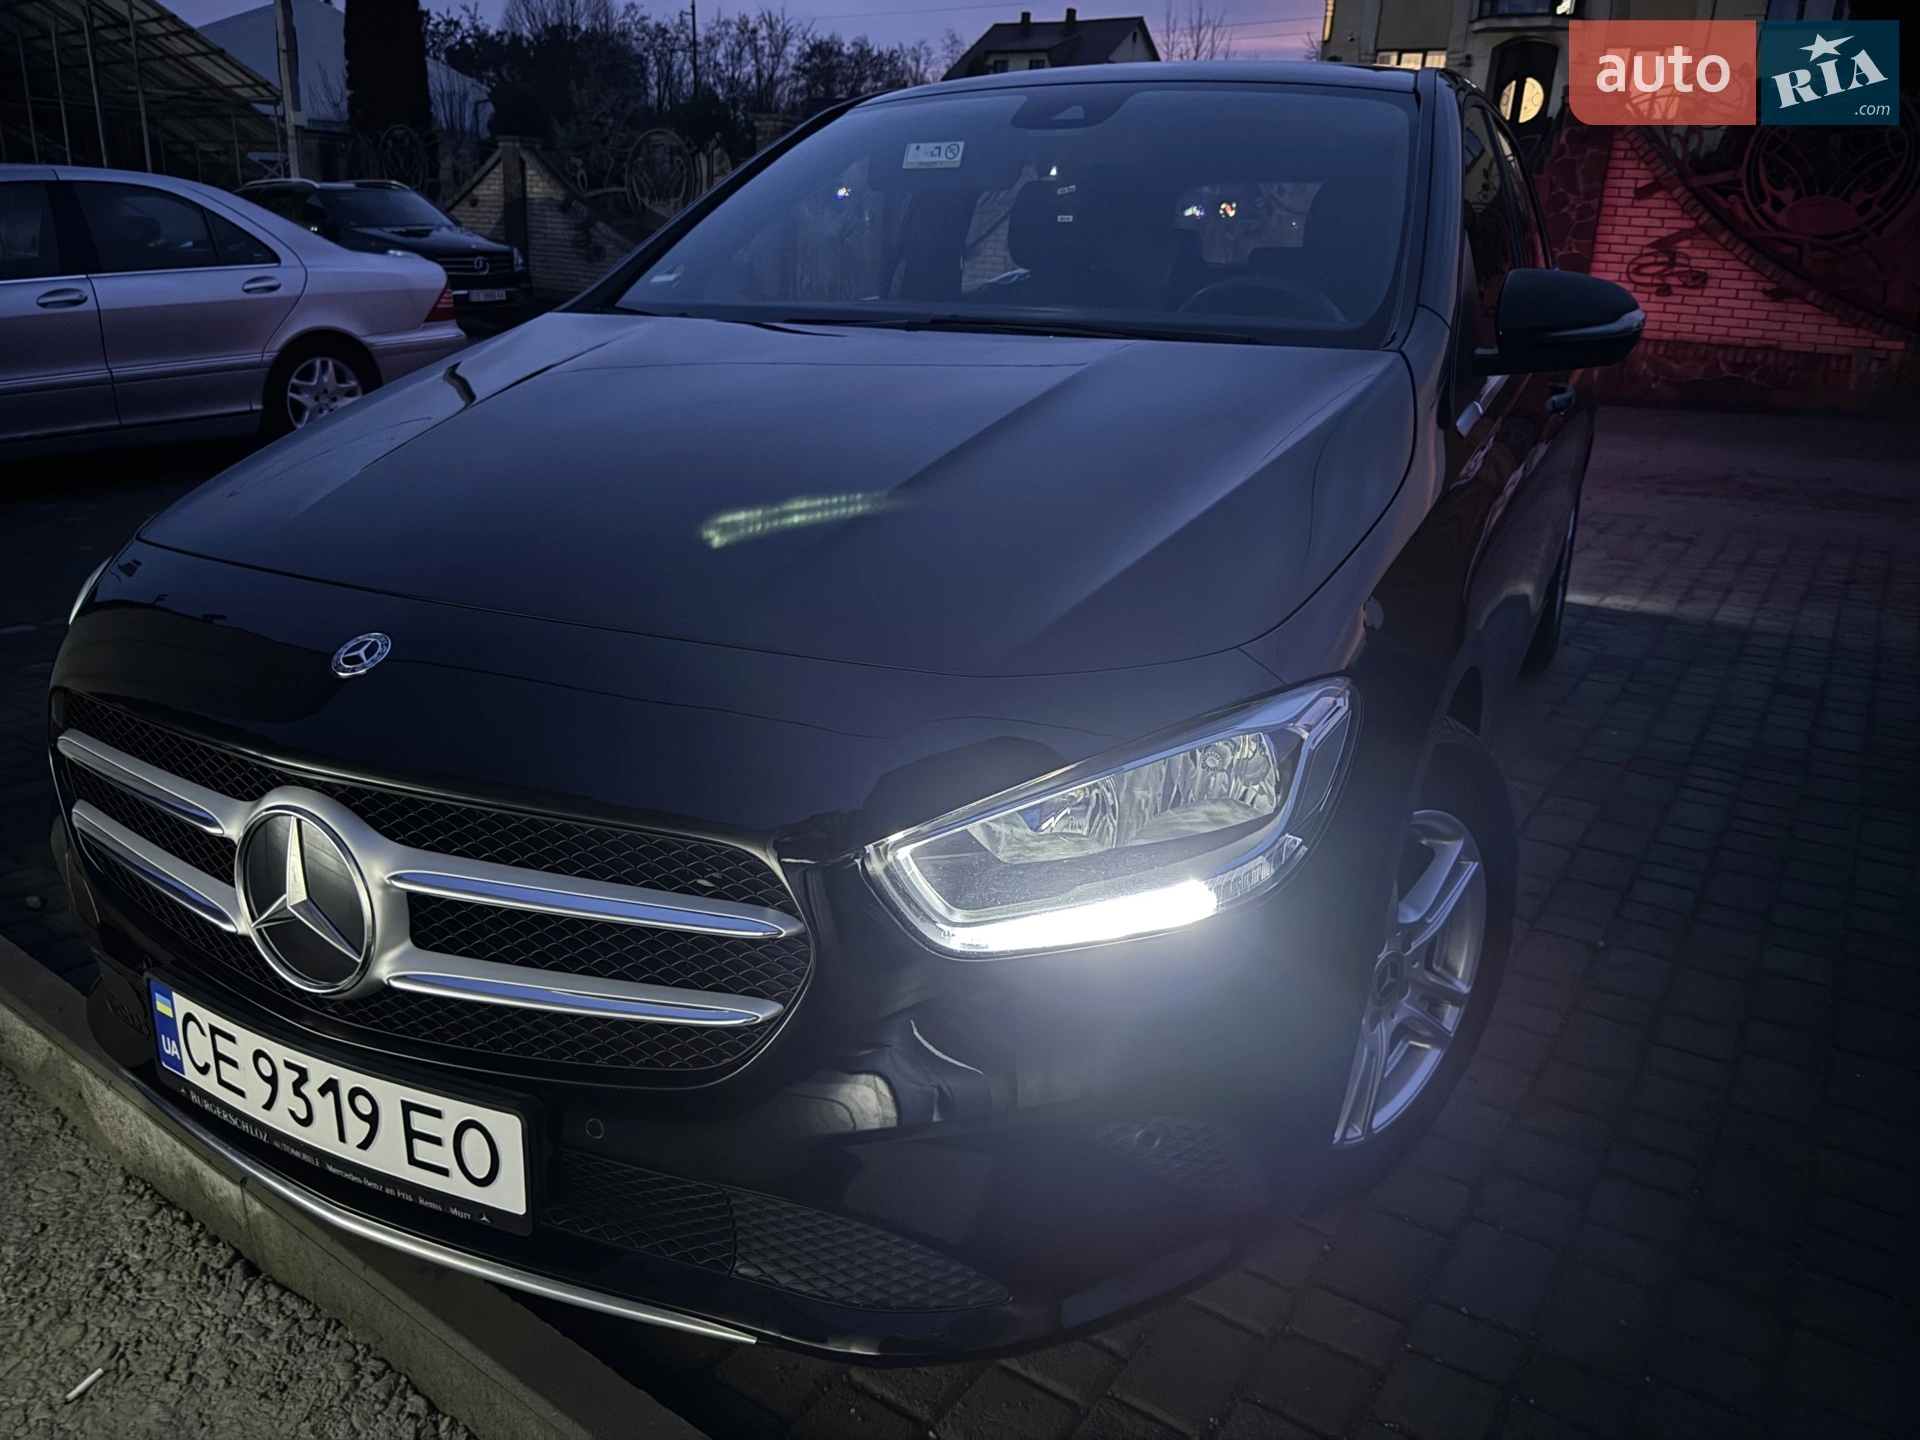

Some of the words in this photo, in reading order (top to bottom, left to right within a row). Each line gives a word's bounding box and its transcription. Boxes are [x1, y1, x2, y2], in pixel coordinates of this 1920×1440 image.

[161, 1034, 181, 1060] UA
[182, 1012, 246, 1099] CE
[253, 1049, 379, 1150] 9319
[400, 1099, 500, 1188] EO
